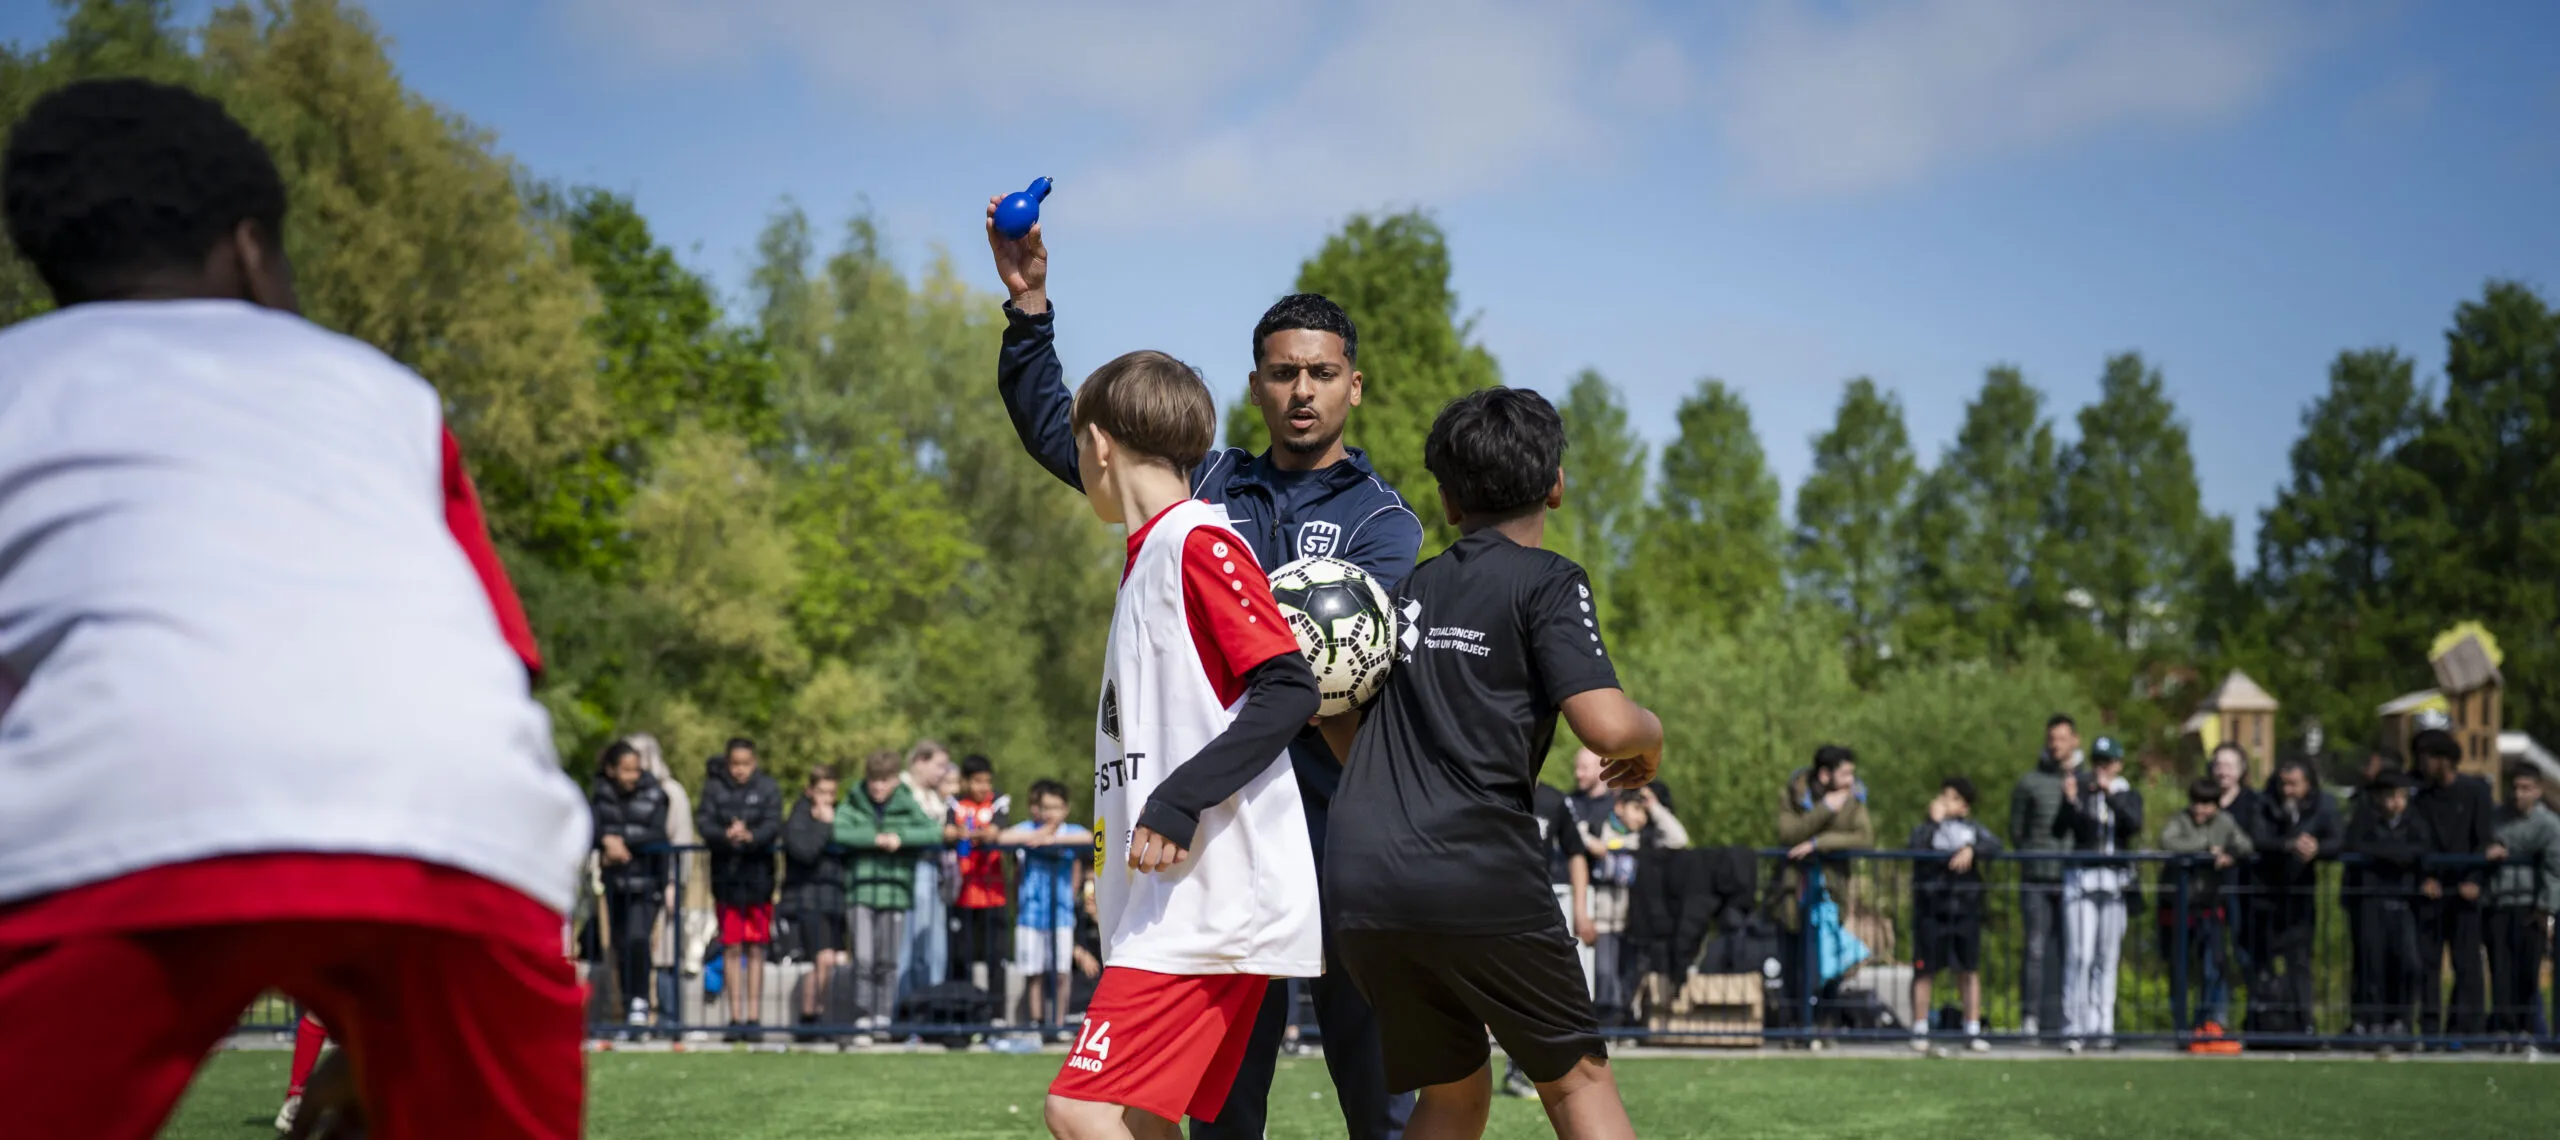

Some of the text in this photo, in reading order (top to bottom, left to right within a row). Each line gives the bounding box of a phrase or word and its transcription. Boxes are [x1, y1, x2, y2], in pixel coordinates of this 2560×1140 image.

[1451, 640, 1492, 657] PROJECT
[1076, 1018, 1110, 1060] 14
[1068, 1055, 1103, 1072] JAKO
